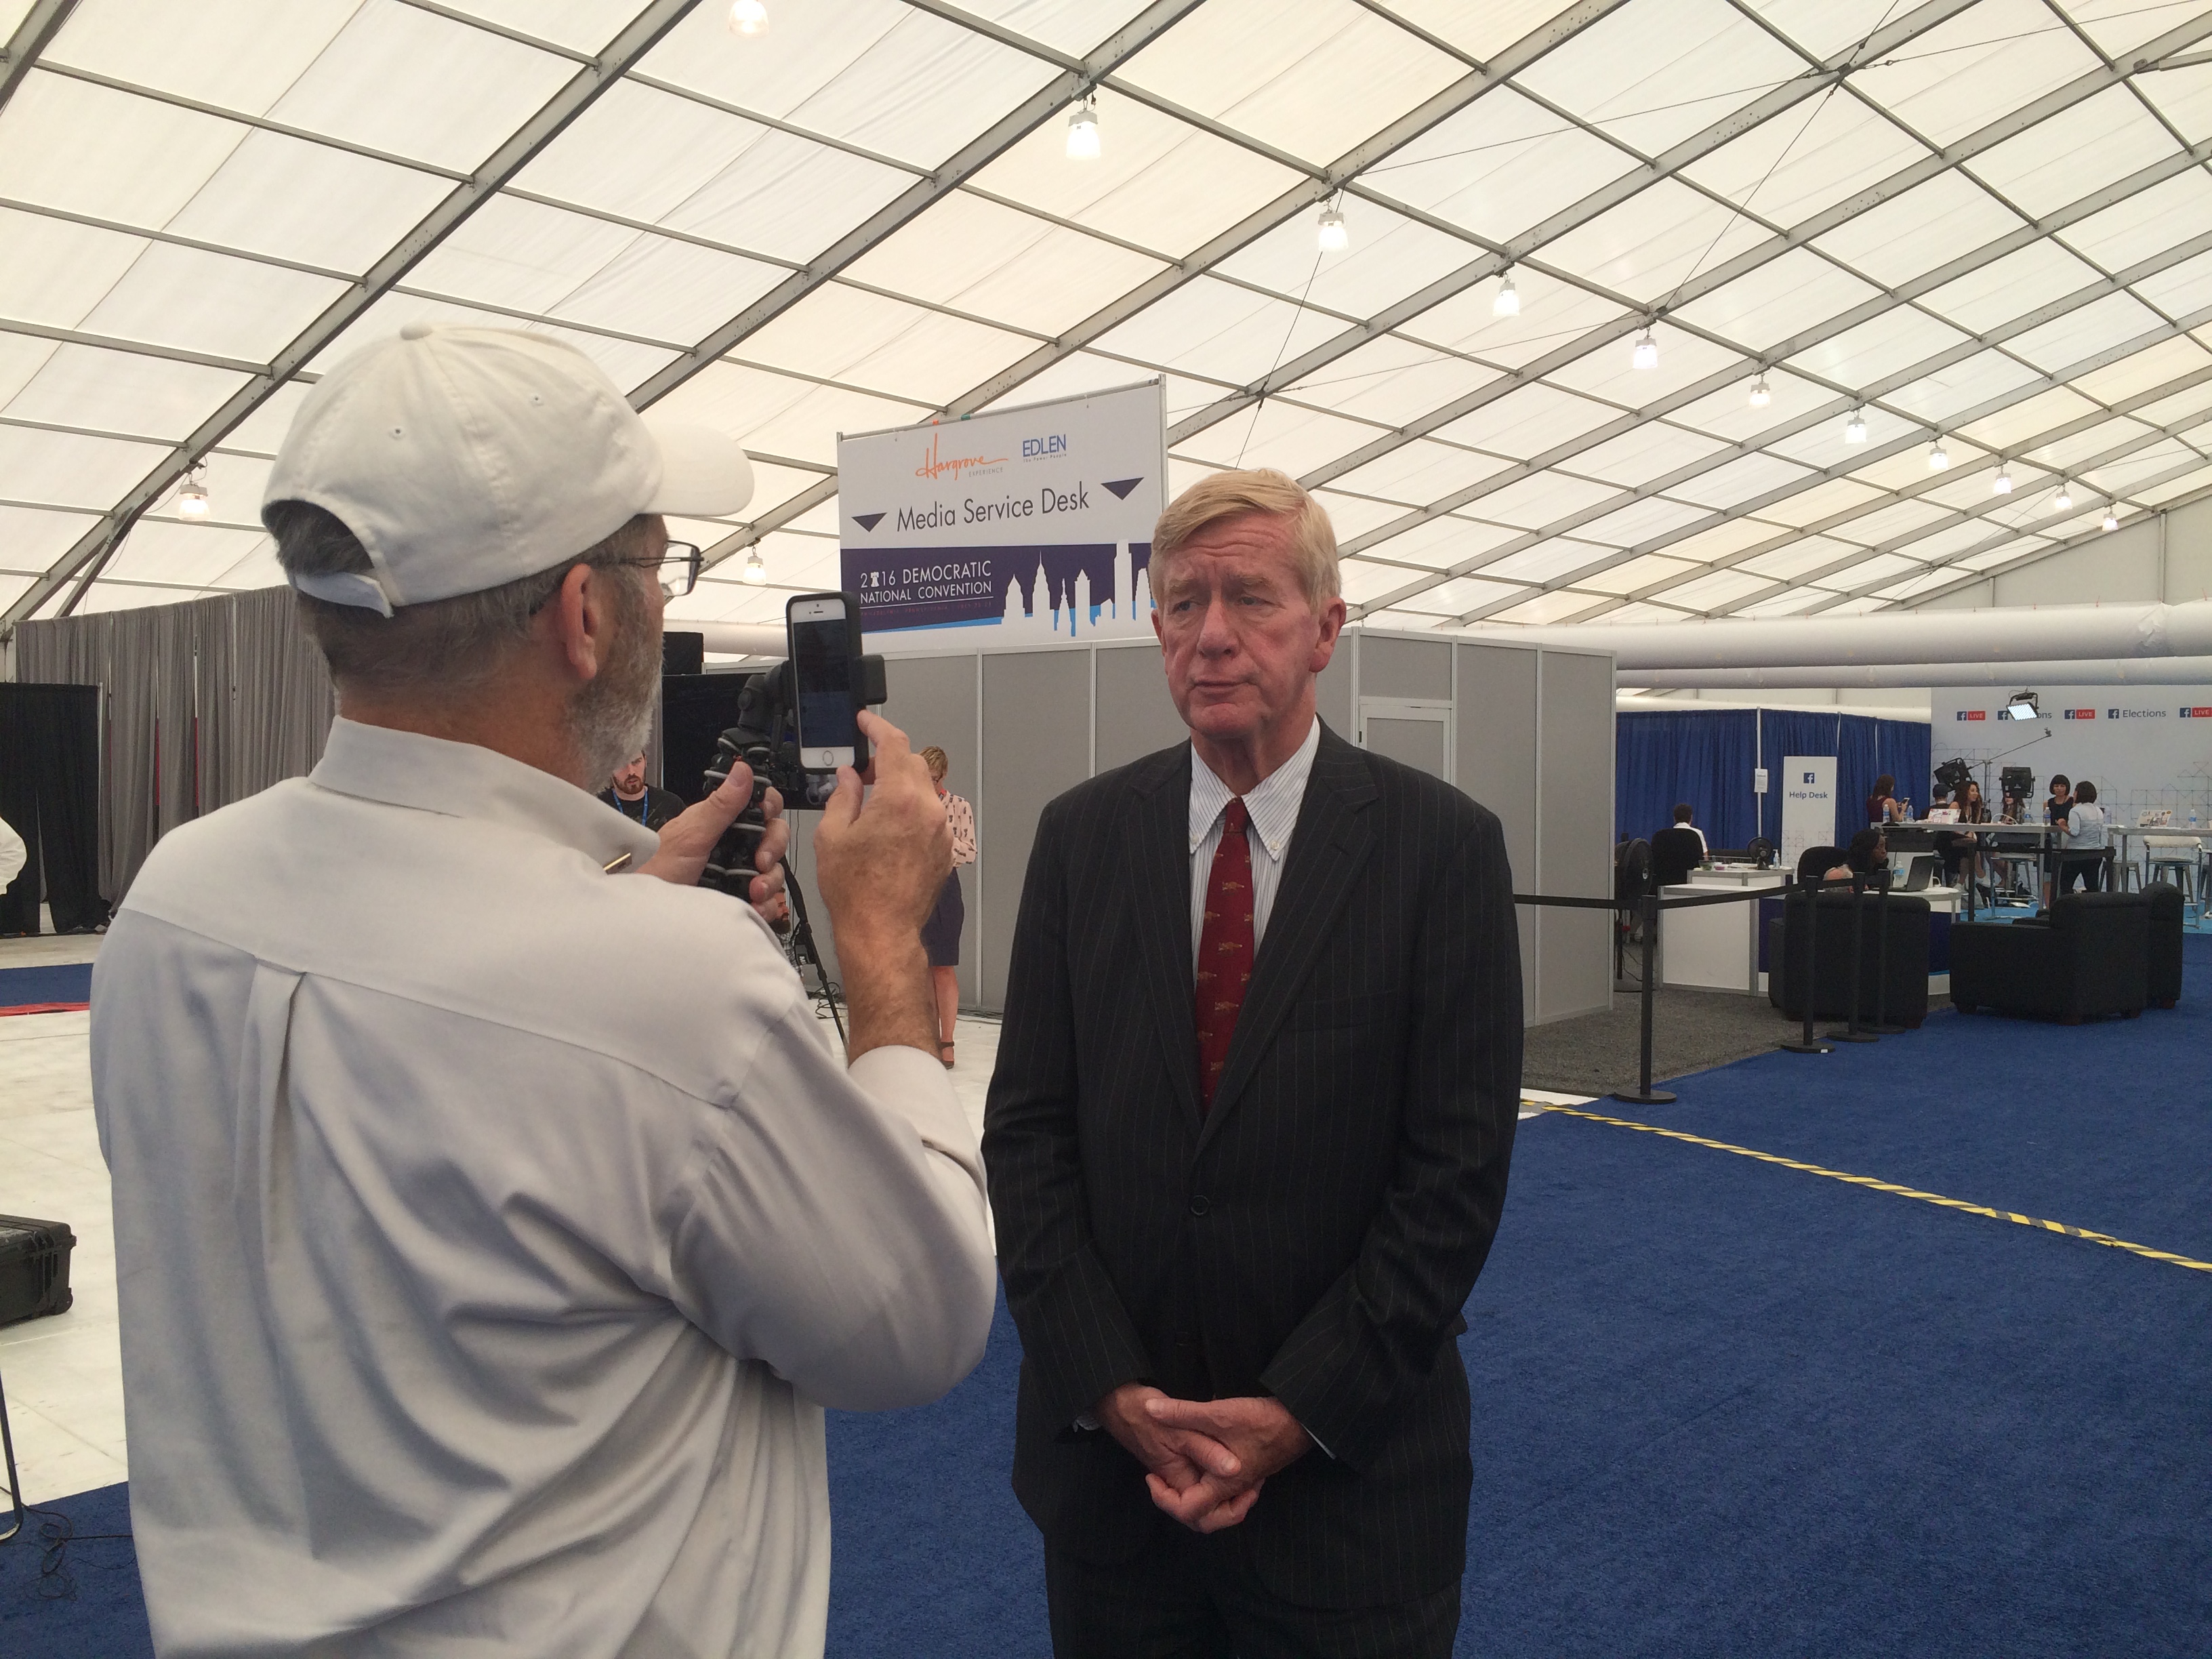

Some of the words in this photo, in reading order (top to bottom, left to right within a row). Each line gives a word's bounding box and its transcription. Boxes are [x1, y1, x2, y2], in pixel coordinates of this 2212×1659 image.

[915, 432, 1008, 480] Hargrove
[1022, 434, 1066, 457] EDLEN
[968, 467, 1004, 477] EXPERIENCE
[897, 501, 956, 533] Media
[964, 495, 1033, 524] Service
[1042, 480, 1090, 514] Desk
[903, 560, 991, 584] DEMOCRATIC
[860, 588, 912, 605] NATIONAL
[918, 580, 991, 599] CONVENTION
[2123, 709, 2166, 718] Elections
[1789, 792, 1807, 800] Help
